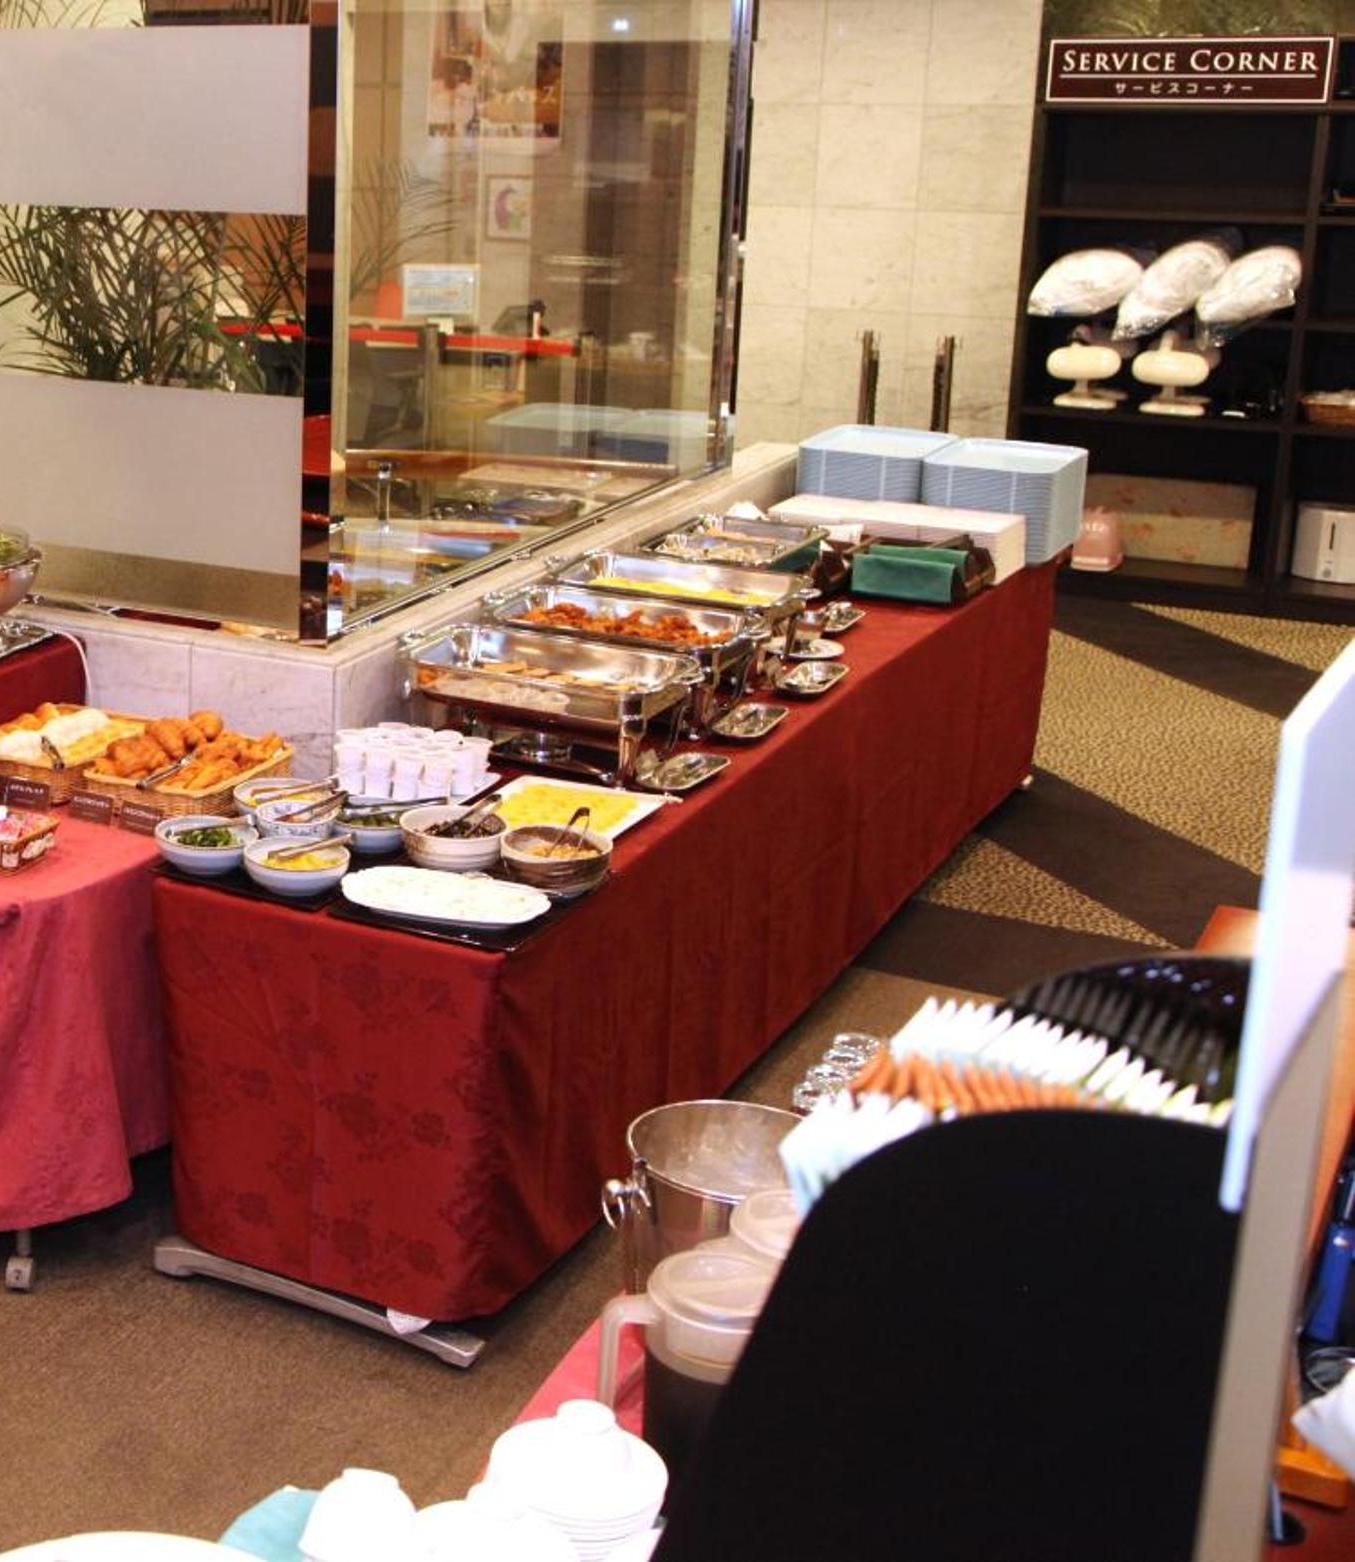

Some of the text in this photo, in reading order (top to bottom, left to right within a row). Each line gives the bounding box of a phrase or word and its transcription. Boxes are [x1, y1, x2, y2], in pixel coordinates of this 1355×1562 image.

[1062, 49, 1319, 72] SERVICE CORNER
[1115, 82, 1253, 94] サービスコーナー
